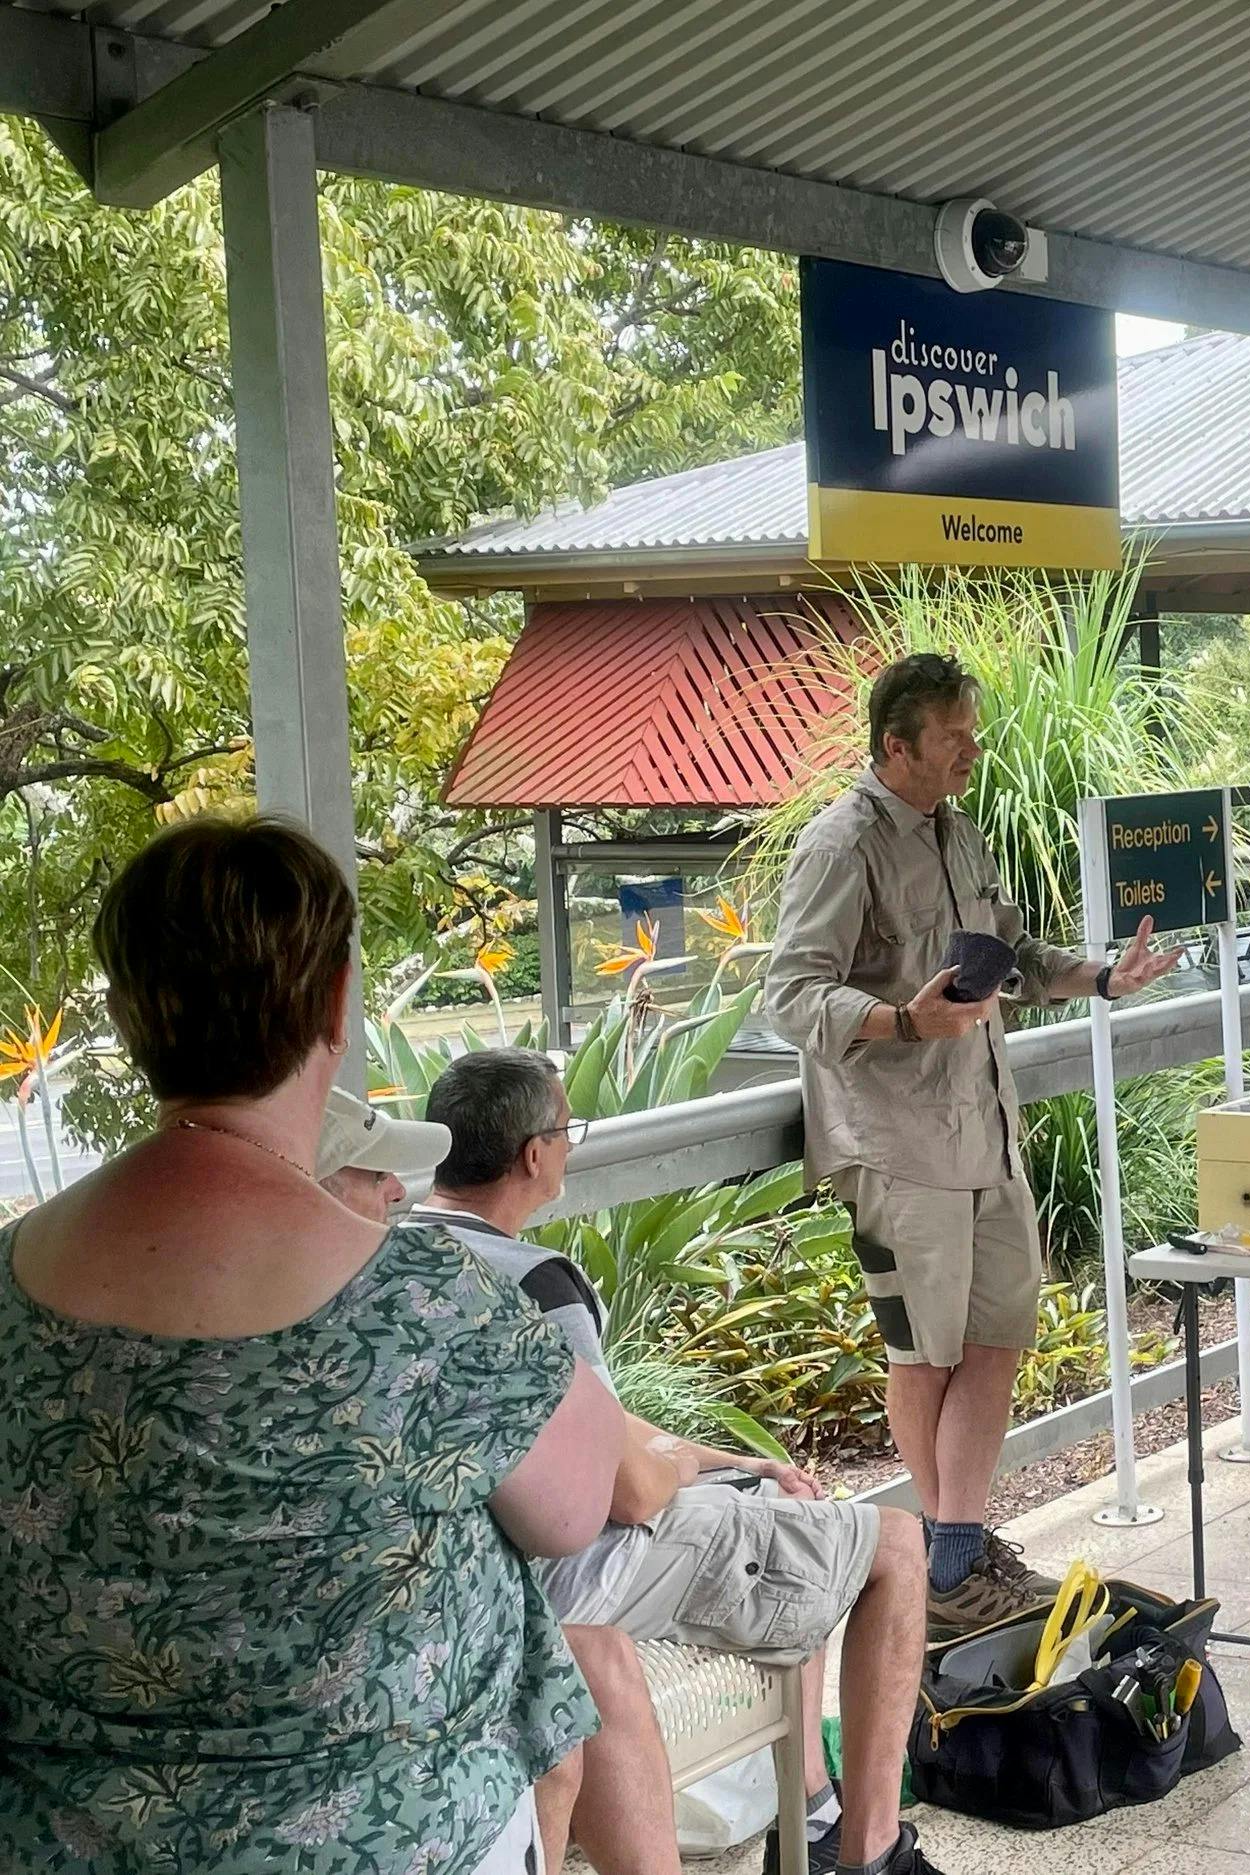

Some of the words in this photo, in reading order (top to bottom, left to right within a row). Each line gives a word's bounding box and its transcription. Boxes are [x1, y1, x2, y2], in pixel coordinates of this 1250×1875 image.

[891, 319, 998, 376] discover
[872, 348, 1077, 456] Ipswich
[941, 513, 1024, 545] Welcome
[1111, 820, 1191, 852] Reception
[1115, 879, 1166, 907] Toilets
